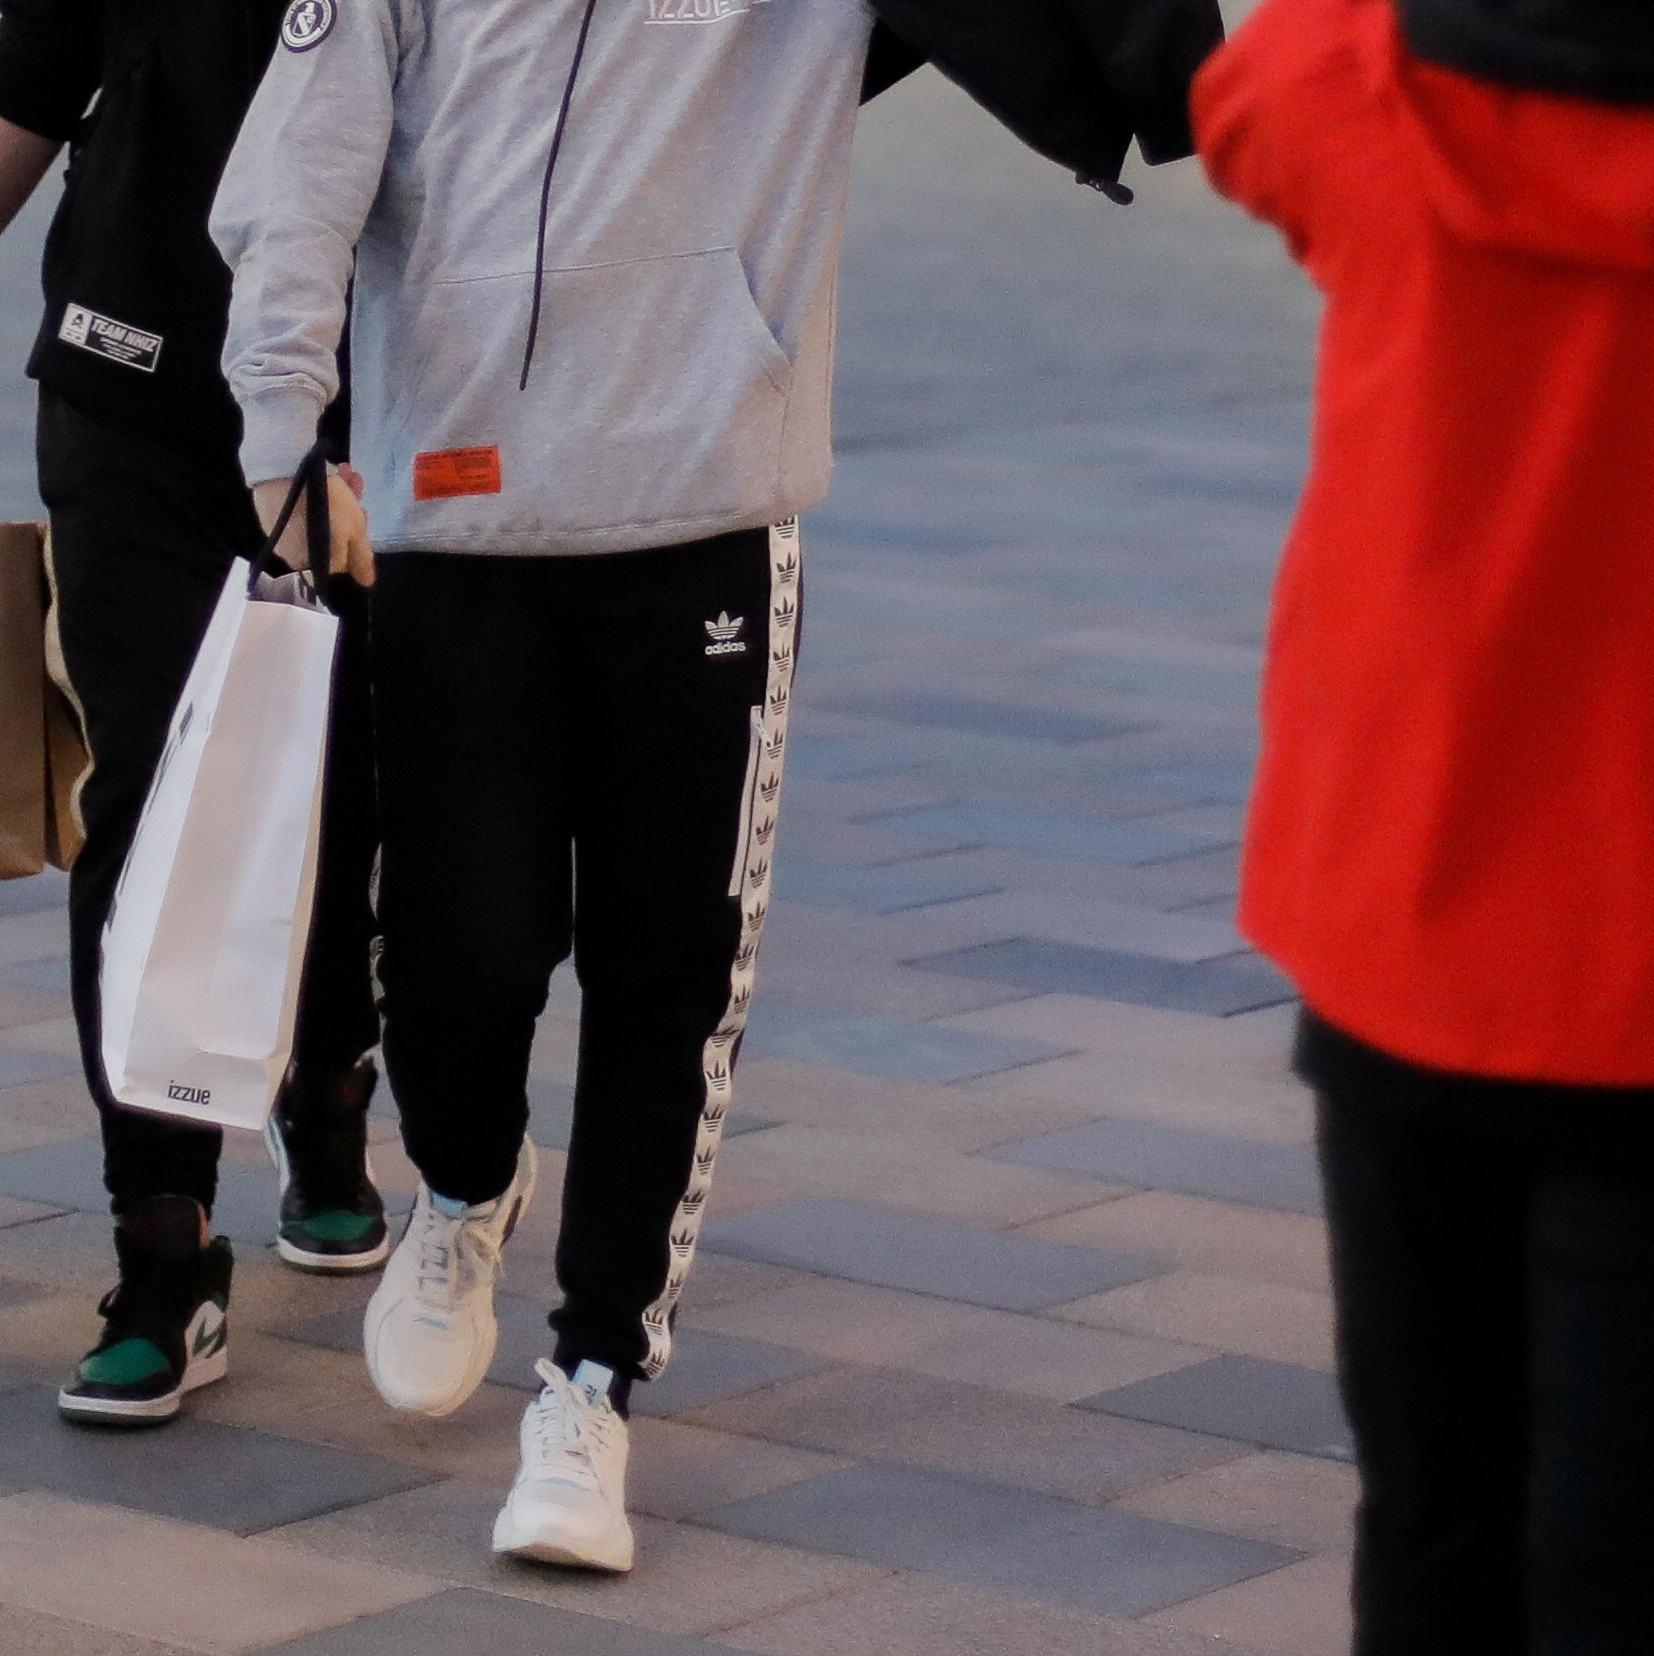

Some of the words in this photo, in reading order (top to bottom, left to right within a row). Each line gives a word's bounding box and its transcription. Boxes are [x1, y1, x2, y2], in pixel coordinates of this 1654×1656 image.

[91, 318, 127, 343] TEAM
[704, 641, 746, 656] adidas
[168, 1079, 211, 1106] izzue
